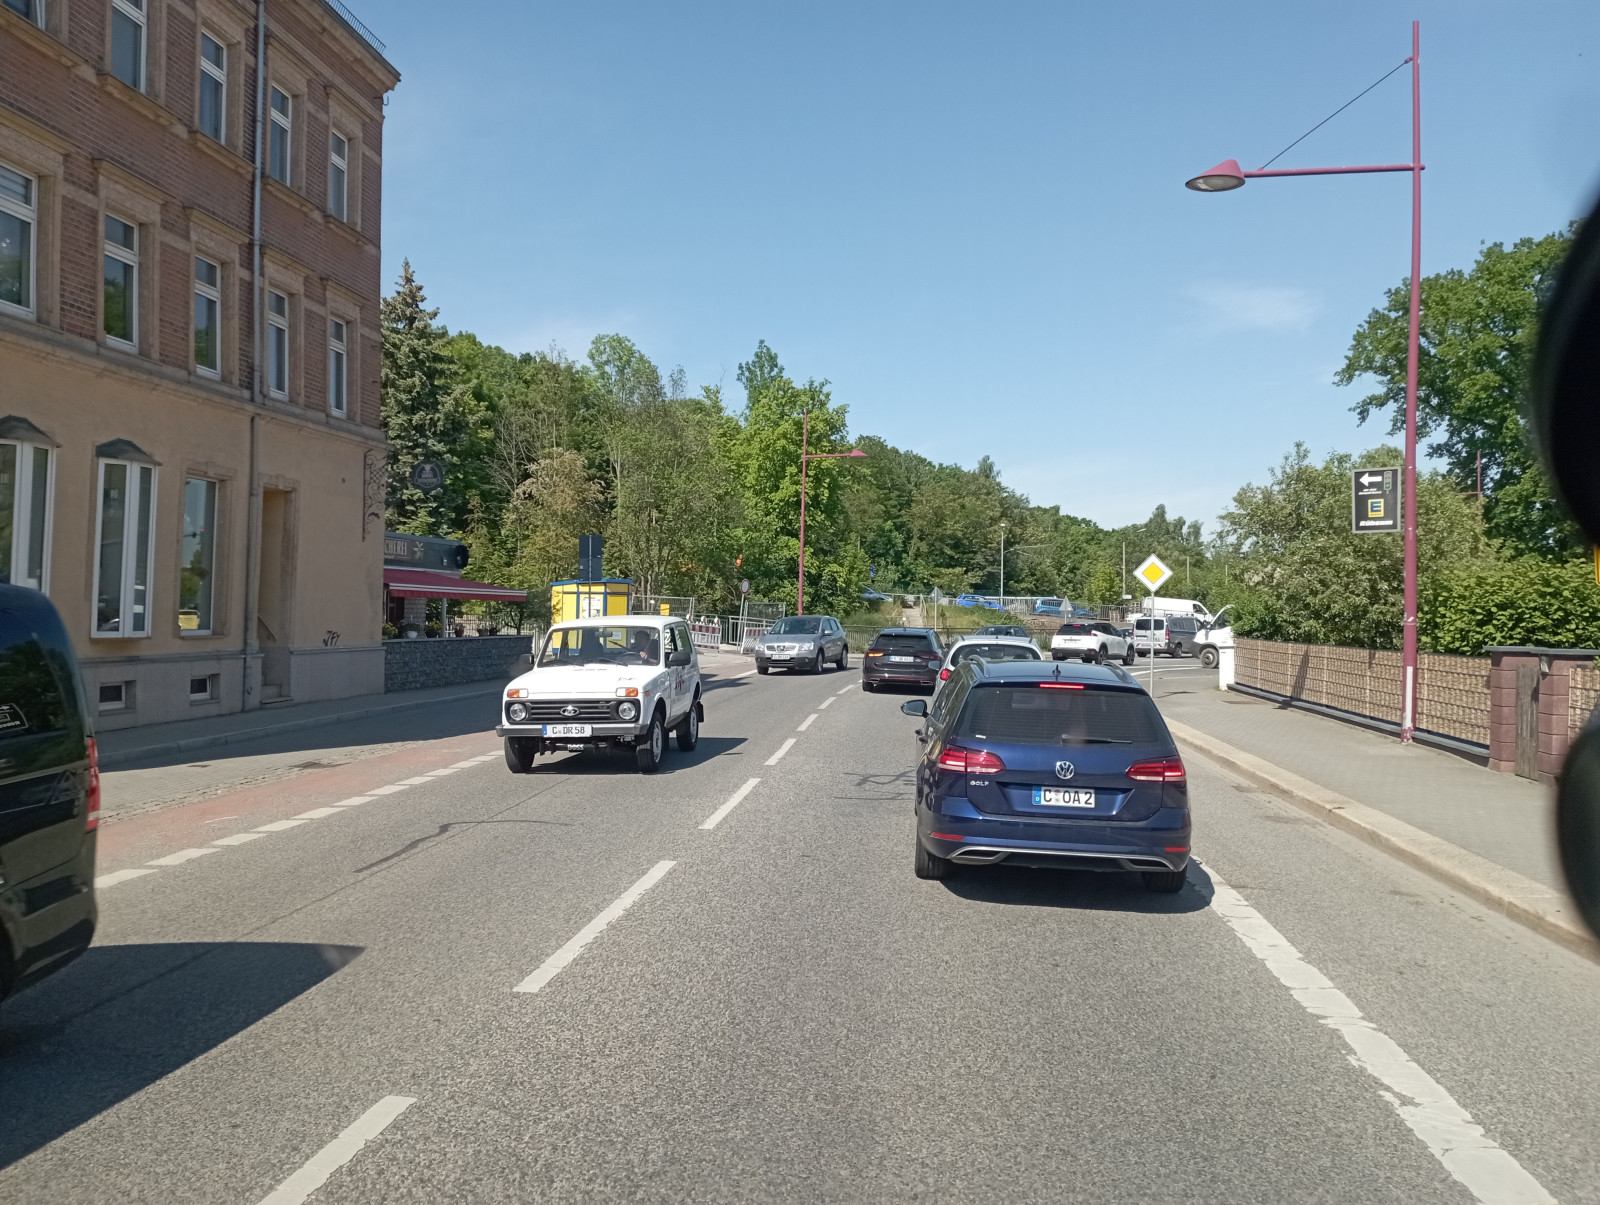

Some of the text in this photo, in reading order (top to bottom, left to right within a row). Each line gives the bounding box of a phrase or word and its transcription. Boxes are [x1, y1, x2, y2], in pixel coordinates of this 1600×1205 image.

[552, 726, 585, 735] C DR 58
[1043, 789, 1093, 805] C OA 2
